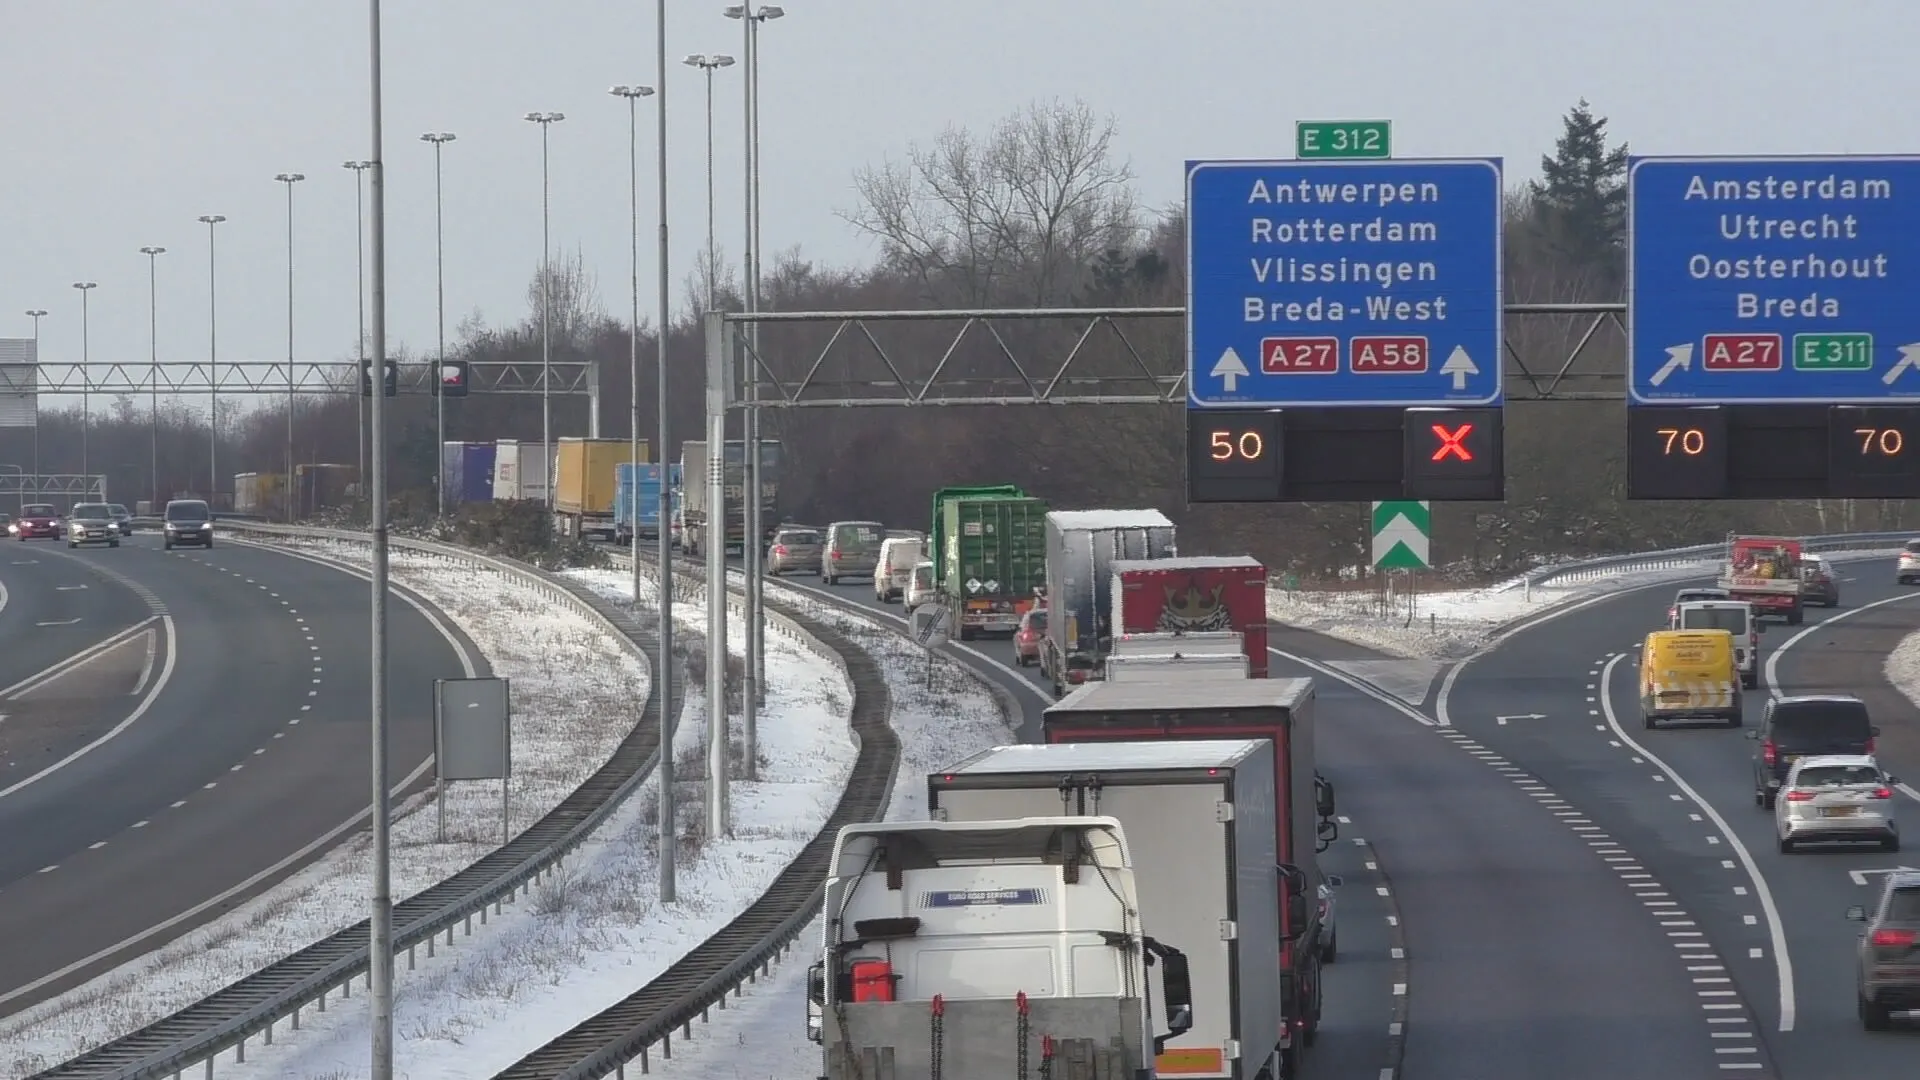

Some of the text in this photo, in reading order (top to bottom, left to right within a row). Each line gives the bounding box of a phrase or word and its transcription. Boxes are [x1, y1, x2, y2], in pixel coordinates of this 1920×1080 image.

[1304, 129, 1380, 151] E 312
[1248, 179, 1438, 207] Antwerpen
[1684, 175, 1890, 200] Amsterdam
[1252, 217, 1437, 243] Rotterdam
[1720, 214, 1857, 239] Utrecht
[1251, 258, 1436, 288] Vlissingen
[1689, 254, 1888, 279] Oosterhout
[1244, 296, 1447, 322] Breda-West
[1737, 292, 1839, 318] Breda
[1269, 344, 1421, 366] A27 A58
[1710, 341, 1774, 363] A27
[1211, 431, 1262, 460] 50
[1657, 430, 1704, 455] 70
[1855, 429, 1902, 454] 70
